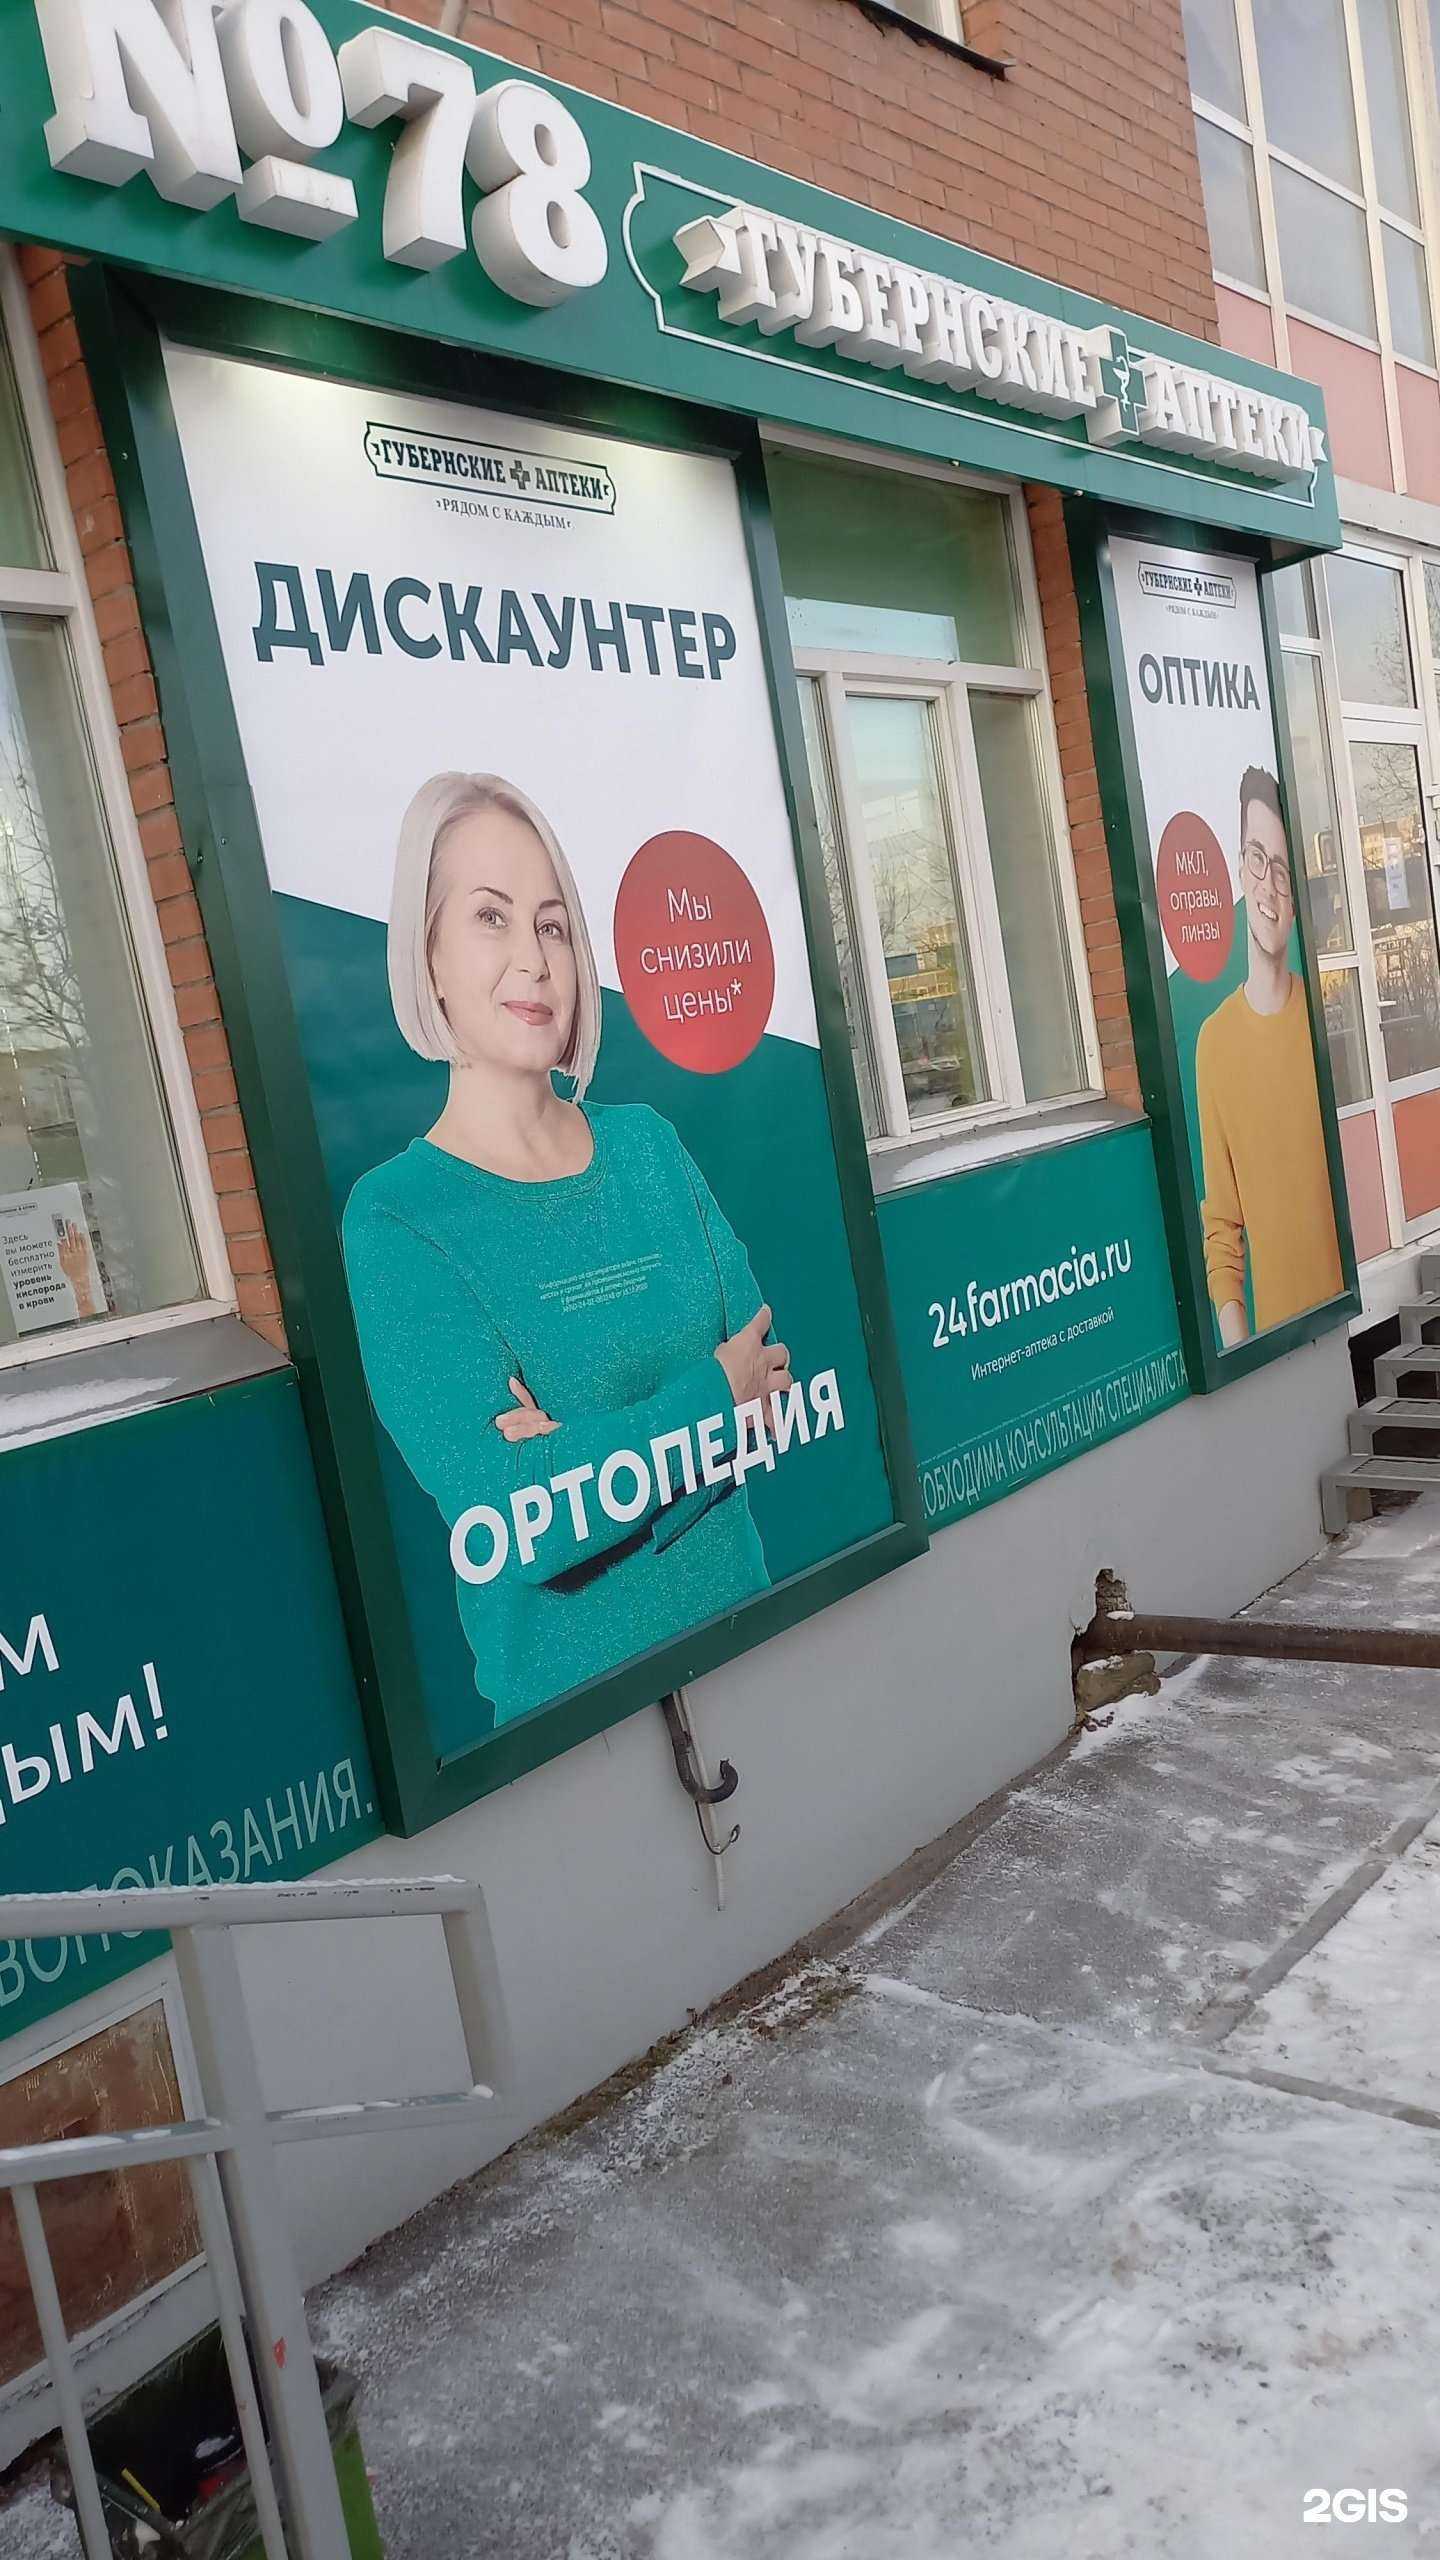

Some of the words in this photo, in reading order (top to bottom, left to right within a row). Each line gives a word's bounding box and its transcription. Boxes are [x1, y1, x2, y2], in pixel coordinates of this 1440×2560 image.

[717, 206, 1098, 421] ГУБЕРНСКИЕ
[1138, 357, 1316, 484] АПТЕКИ
[380, 437, 507, 484] ГУБЕРНСКИЕ
[534, 466, 605, 501] АПТЕКИ
[442, 497, 490, 519] РЯДОМ
[492, 506, 502, 519] С
[505, 507, 567, 530] КАЖДЫМ
[252, 561, 737, 681] ДИСКАУНТЕР
[1138, 653, 1262, 711] ОПТИКА
[1175, 850, 1209, 877] МКЛ,
[666, 887, 713, 923] Мы
[1170, 888, 1222, 916] оправы,
[1181, 921, 1221, 944] линзы
[639, 939, 752, 975] снизили
[1, 1233, 29, 1245] Здесь
[19, 1240, 53, 1253] можете
[8, 1250, 55, 1267] бесплатно
[10, 1262, 53, 1278] измерить
[13, 1273, 53, 1291] уровень
[16, 1282, 67, 1301] кислорода
[927, 1238, 1133, 1349] 24farmacia.ru
[26, 1295, 56, 1310] крови
[970, 1335, 1059, 1381] Интернет-аптека
[1066, 1306, 1115, 1342] доставкой
[919, 1438, 1009, 1520] ОБХОДИМА
[1005, 1387, 1107, 1475] КОНСУЛЬТАЦИЯ
[1105, 1347, 1190, 1422] СПЕЦИАЛИСТА
[449, 1368, 846, 1585] ОРТОПЕДИЯ
[0, 1661, 169, 1826] ым!
